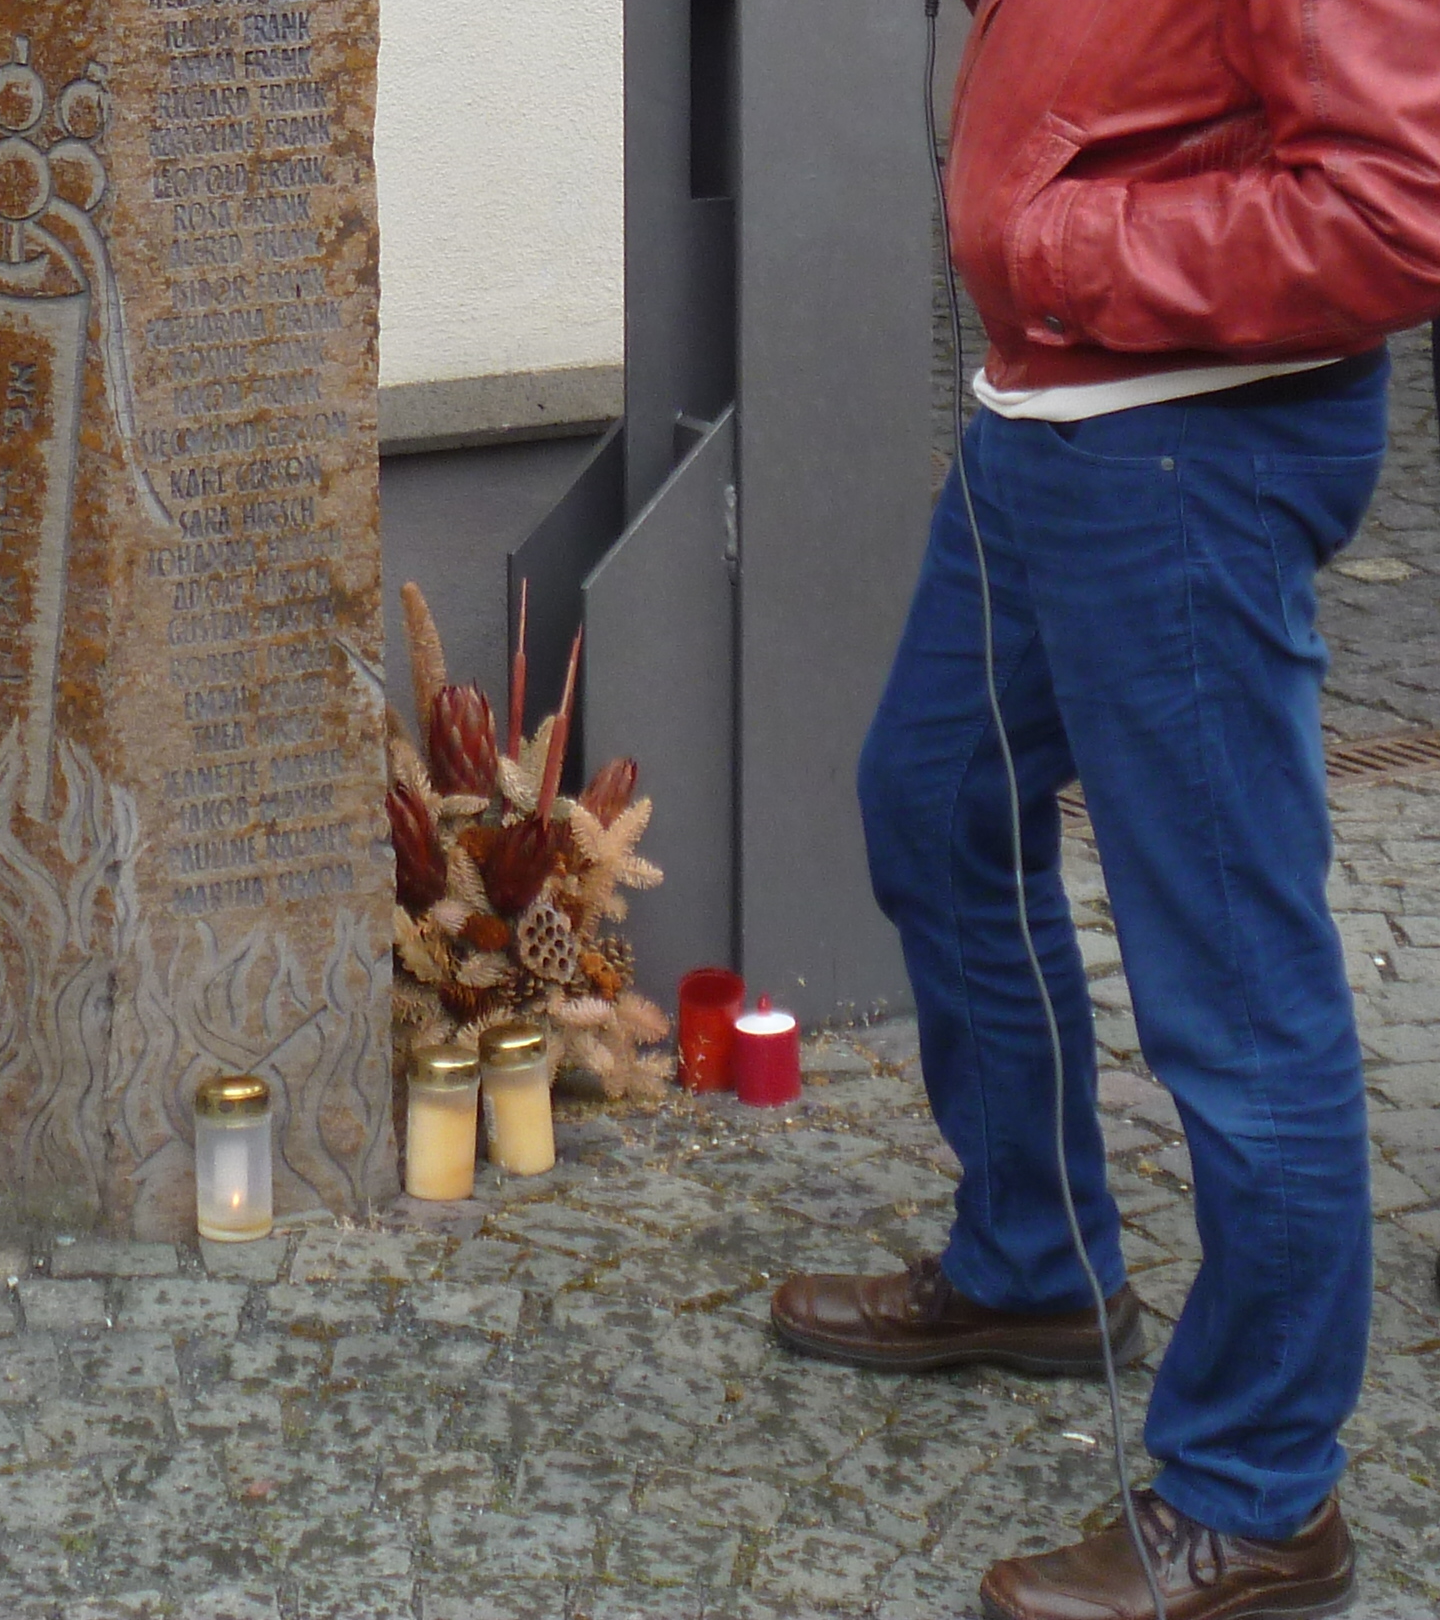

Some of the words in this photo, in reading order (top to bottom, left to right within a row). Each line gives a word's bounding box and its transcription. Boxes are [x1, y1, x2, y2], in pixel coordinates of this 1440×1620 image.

[244, 11, 311, 46] FRANK
[244, 45, 312, 79] FRANK
[158, 87, 250, 121] RICHARD
[260, 81, 328, 114] FRANK
[150, 122, 255, 158] KAROLINE
[265, 113, 332, 149] FRANK
[153, 163, 249, 201] LEOPOLD
[260, 156, 328, 190] FRANK
[174, 201, 231, 231] ROSA
[243, 192, 310, 225] FRANK
[170, 234, 243, 269] ALFRED
[254, 228, 322, 262] FRANK
[172, 275, 248, 311] ISIDOR
[258, 268, 326, 302] FRANK
[275, 301, 343, 336] FRANK
[140, 422, 258, 458] SIEGMUND
[170, 467, 227, 500] KARL
[236, 454, 323, 492] GERSON
[179, 506, 232, 539] SARA
[243, 496, 316, 530] HIRSCH
[148, 539, 256, 578] JOHANNA
[168, 611, 250, 647] GUSTAV
[170, 650, 258, 688] ROBERT
[193, 720, 245, 756] THEA
[180, 796, 249, 832] JAKOB
[167, 836, 256, 874] PAULINE
[173, 876, 266, 915] MARTHA
